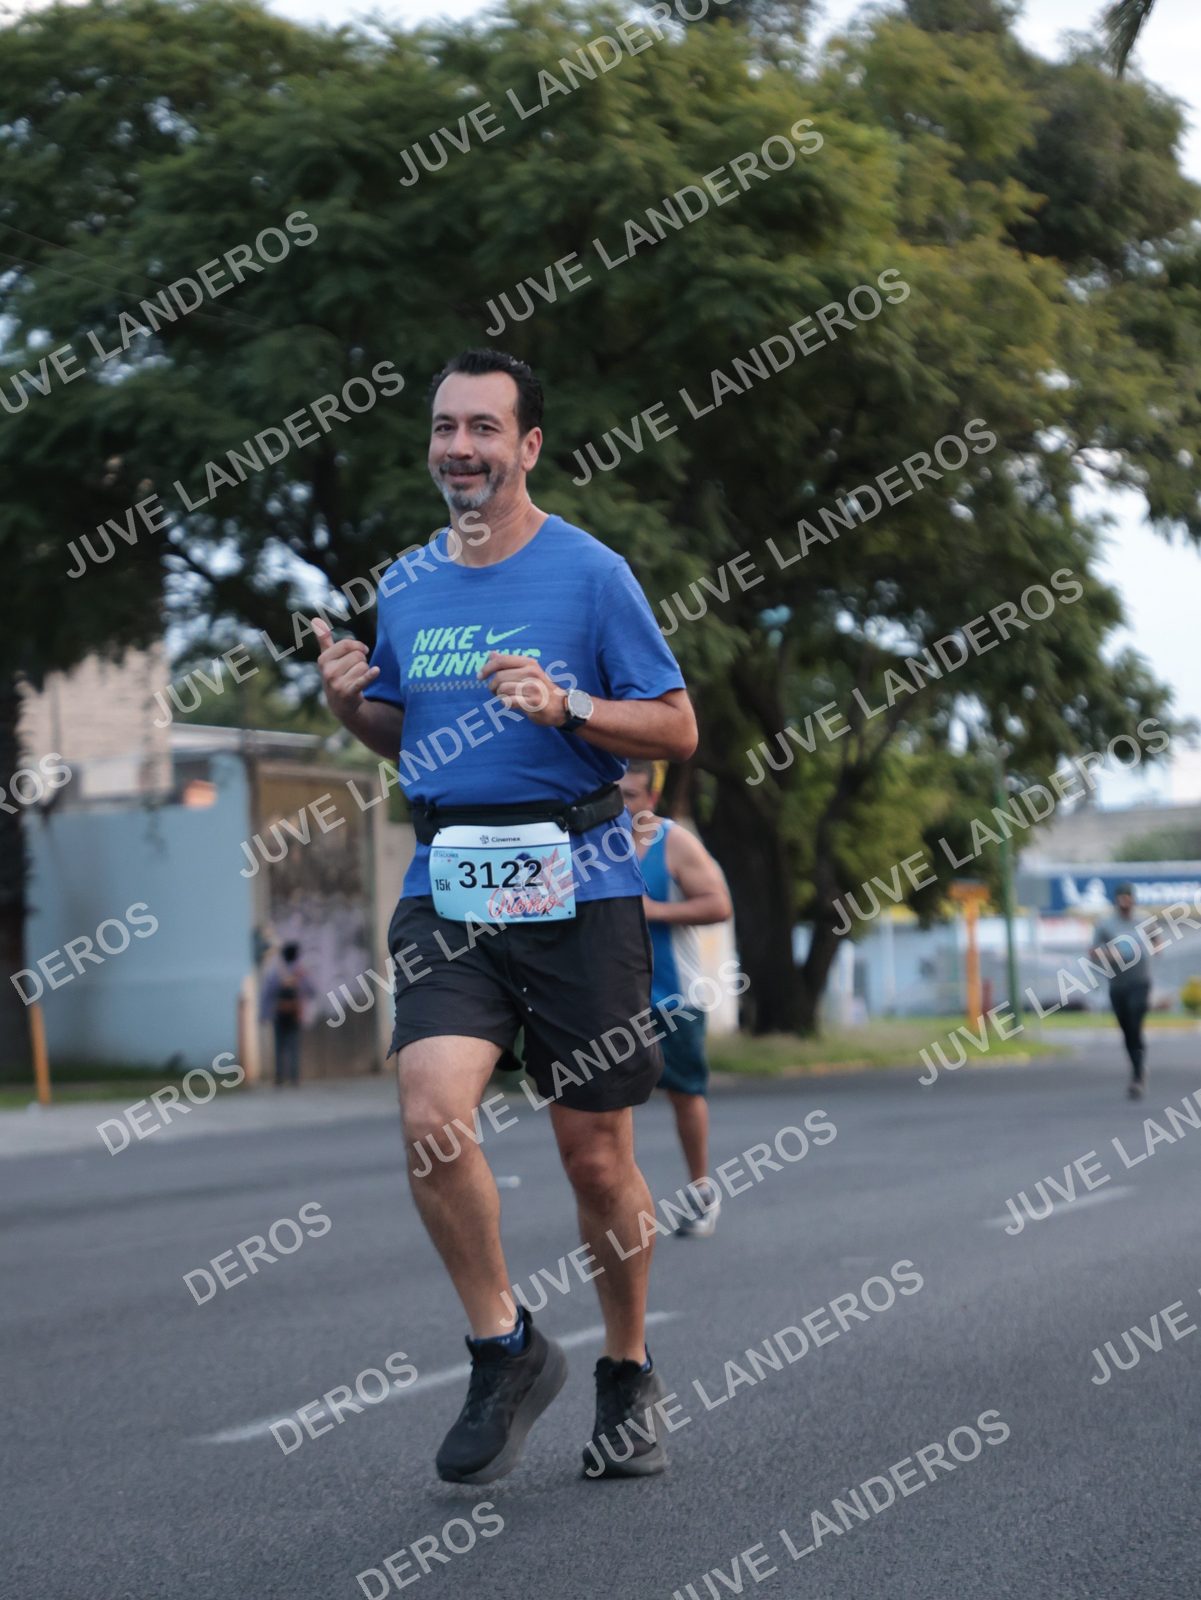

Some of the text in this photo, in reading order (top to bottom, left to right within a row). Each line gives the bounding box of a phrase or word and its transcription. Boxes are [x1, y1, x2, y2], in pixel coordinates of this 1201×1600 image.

[411, 625, 482, 654] NIKE
[407, 648, 541, 679] RUNN
[491, 835, 520, 843] Cinemex
[458, 859, 544, 888] 3122
